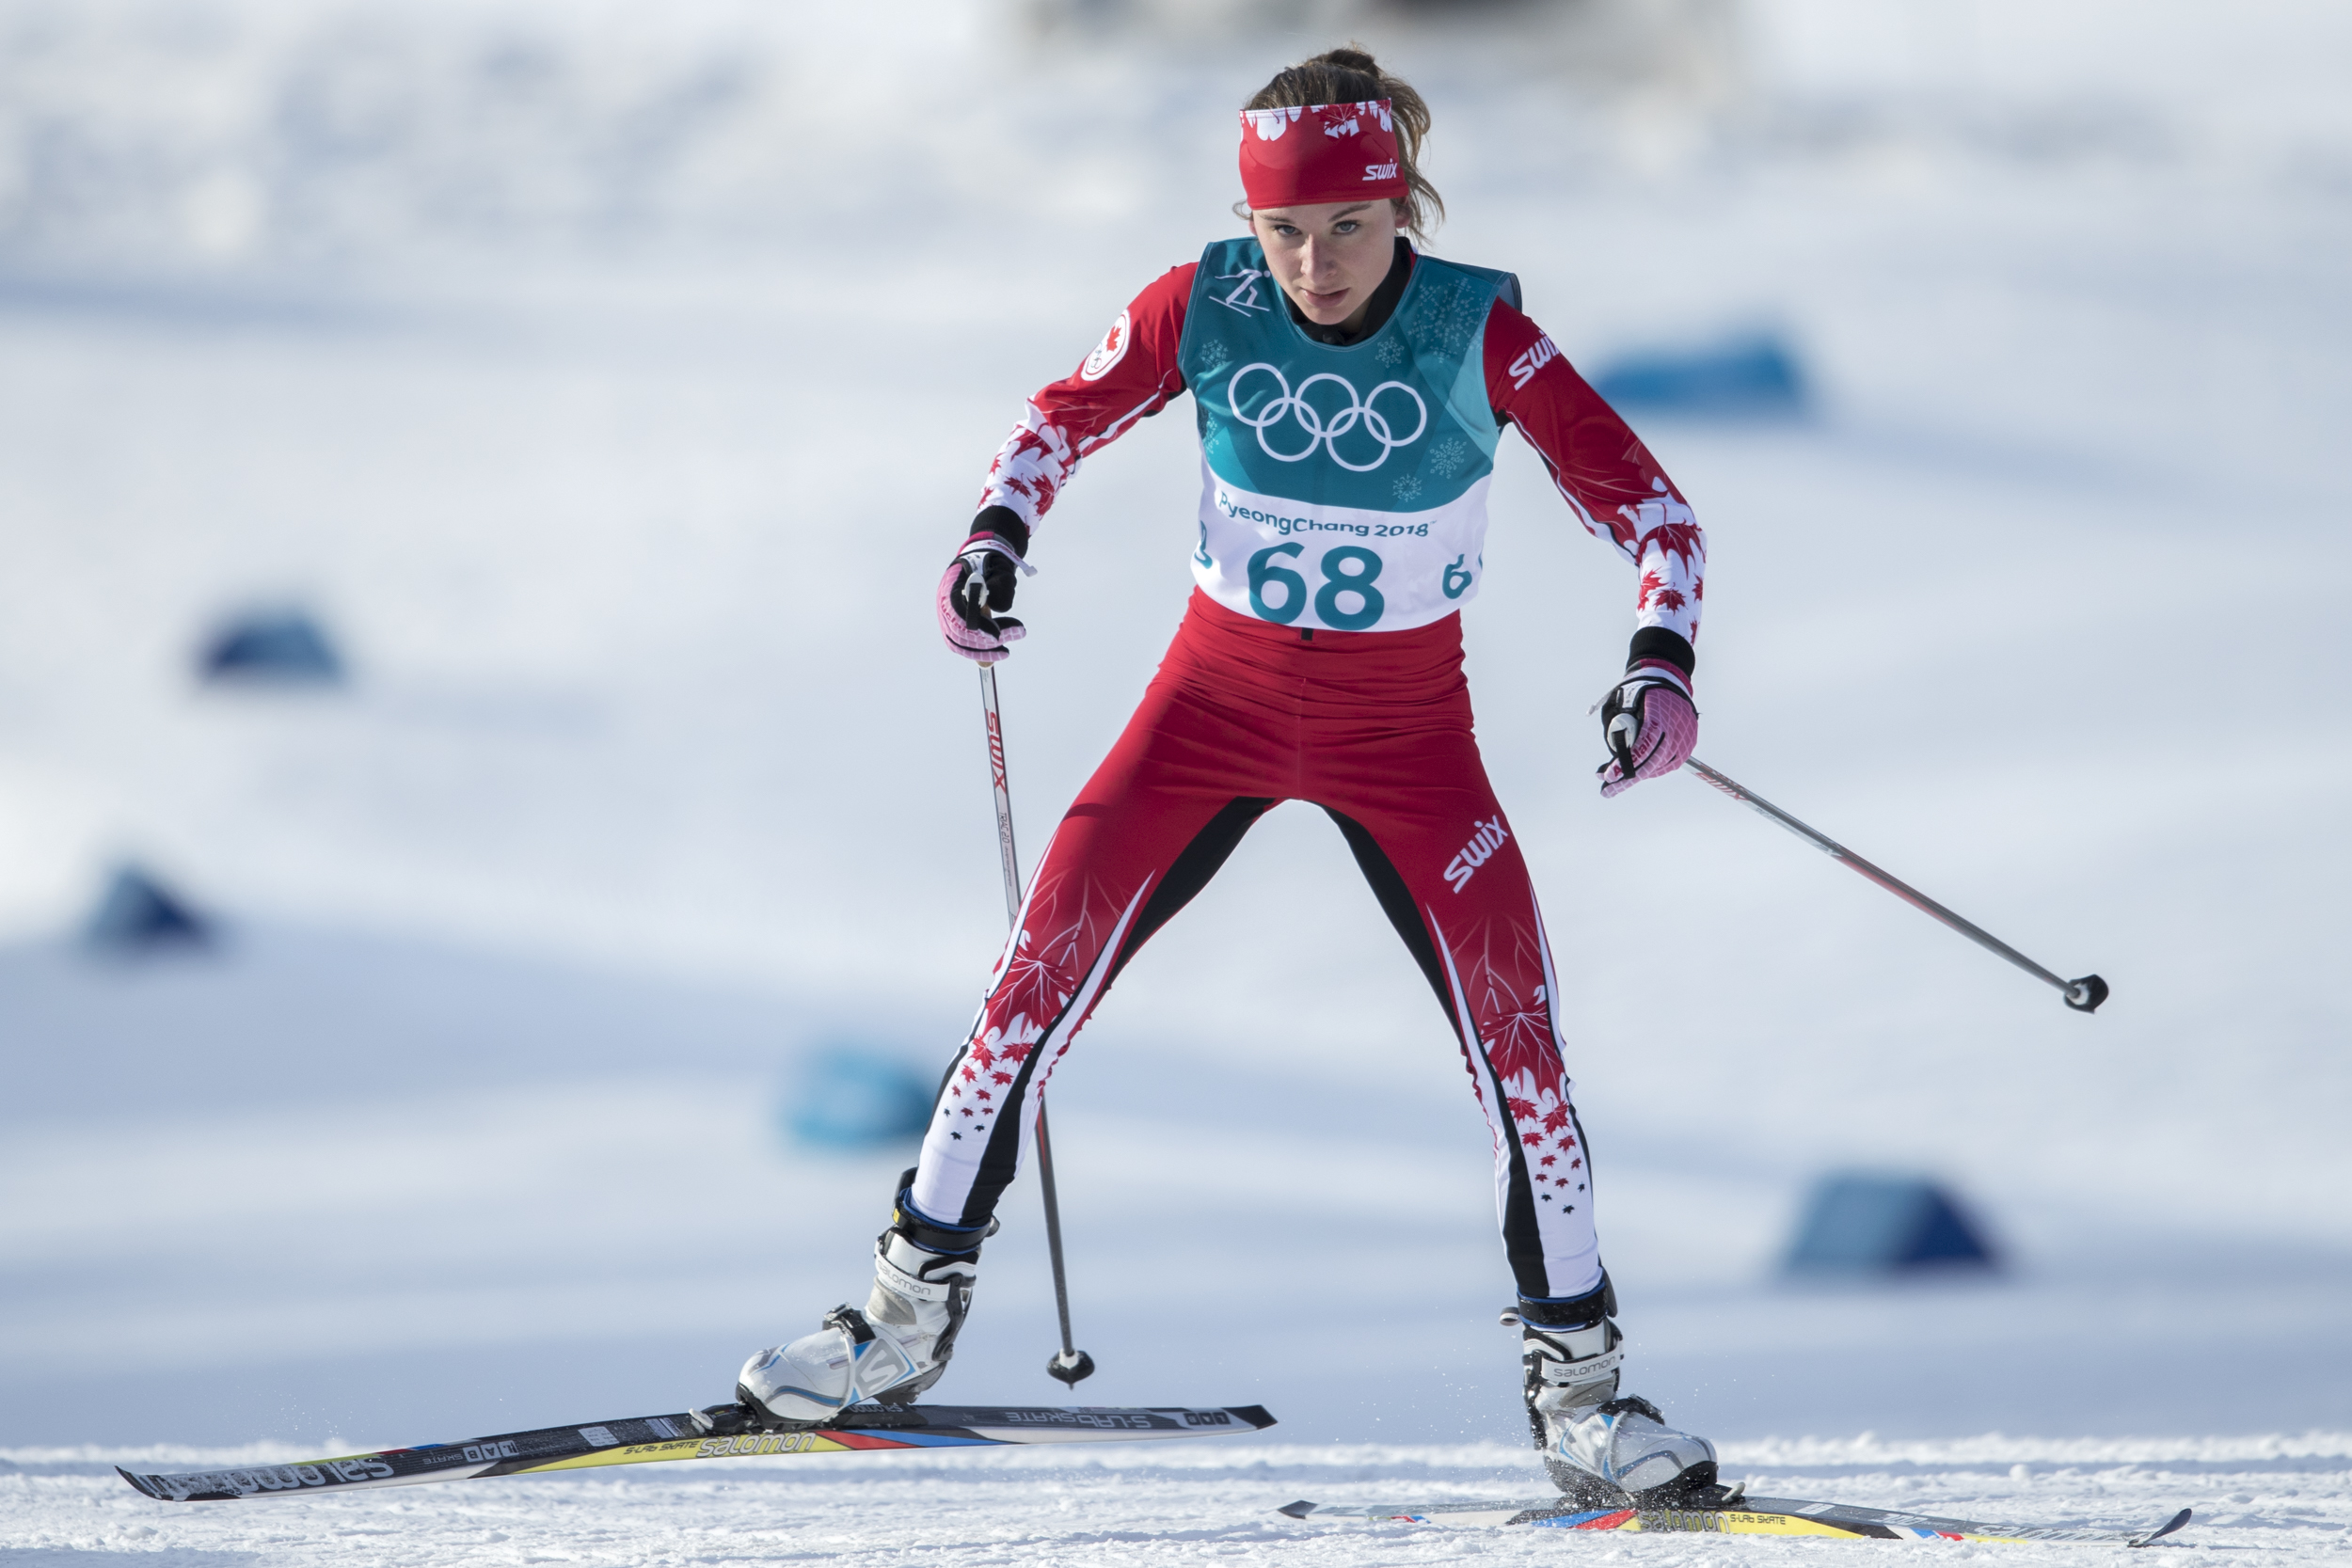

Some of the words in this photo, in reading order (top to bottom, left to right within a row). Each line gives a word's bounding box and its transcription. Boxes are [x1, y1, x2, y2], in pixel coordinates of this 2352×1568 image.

[1219, 490, 1370, 537] PyeongChang
[1374, 523, 1428, 537] 2018
[1247, 542, 1385, 631] 68
[1613, 732, 1653, 778] Aclair
[1005, 1411, 1079, 1423] SKATE
[659, 1440, 700, 1451] SKATE
[422, 1453, 463, 1465] SKATE
[1757, 1514, 1787, 1525] SKATE
